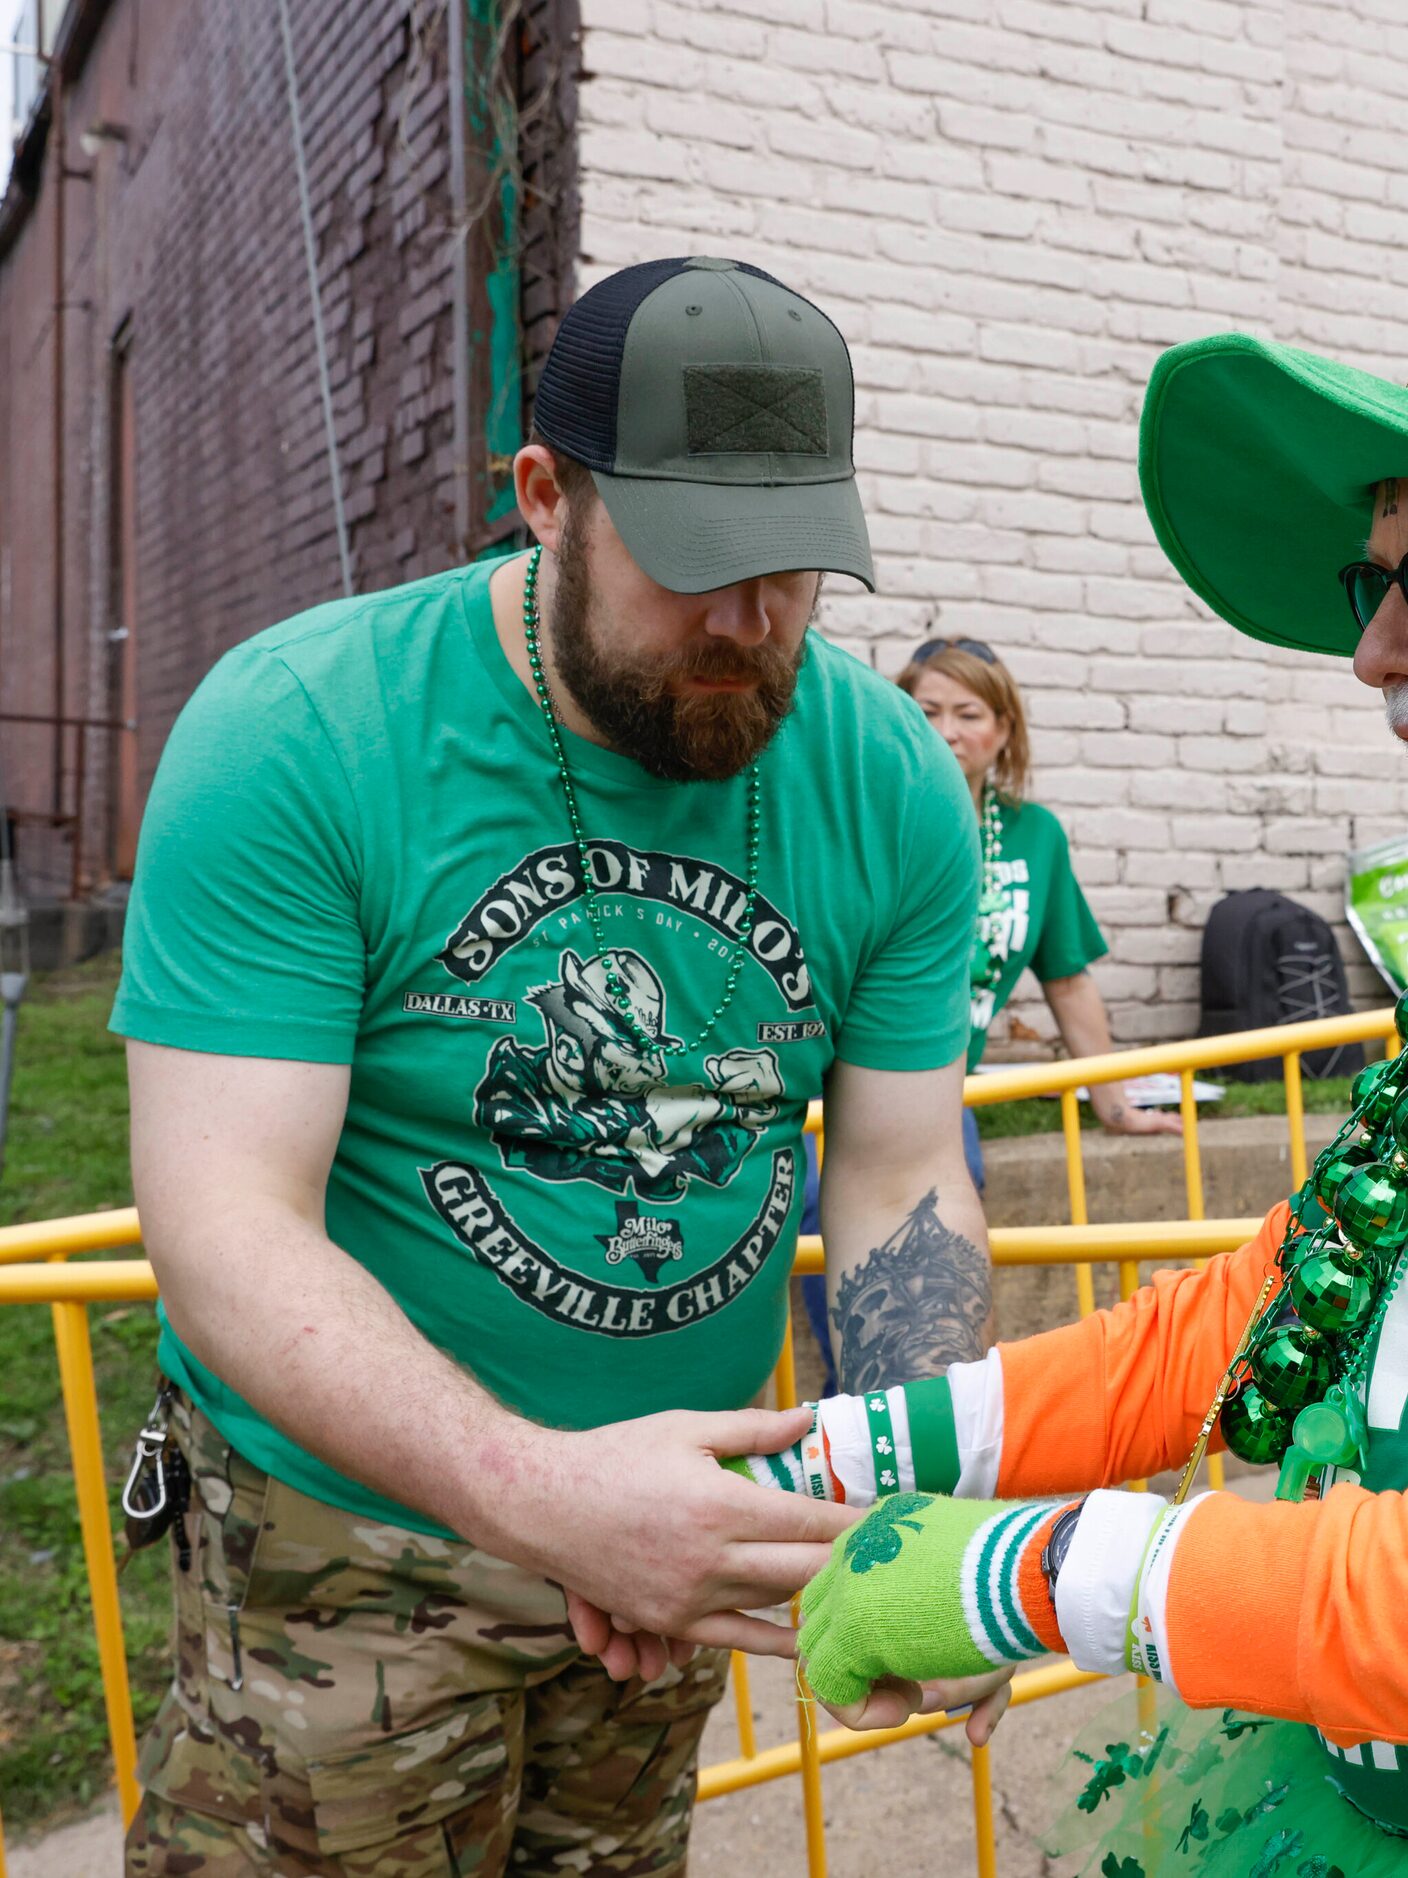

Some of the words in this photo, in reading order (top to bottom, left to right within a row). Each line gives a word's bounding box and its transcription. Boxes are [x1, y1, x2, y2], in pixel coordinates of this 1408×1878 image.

[452, 854, 576, 972] SONS
[583, 848, 651, 892] OF
[558, 904, 645, 930] PARICK'S
[655, 912, 683, 933] DAY
[762, 1024, 797, 1041] EST.
[802, 1021, 827, 1038] 197
[620, 1216, 672, 1238] Milo
[434, 1165, 656, 1332] GREEVILLE
[666, 1154, 795, 1324] CHAPTER
[605, 1231, 683, 1265] Butterfingers
[810, 1473, 827, 1497] KISS
